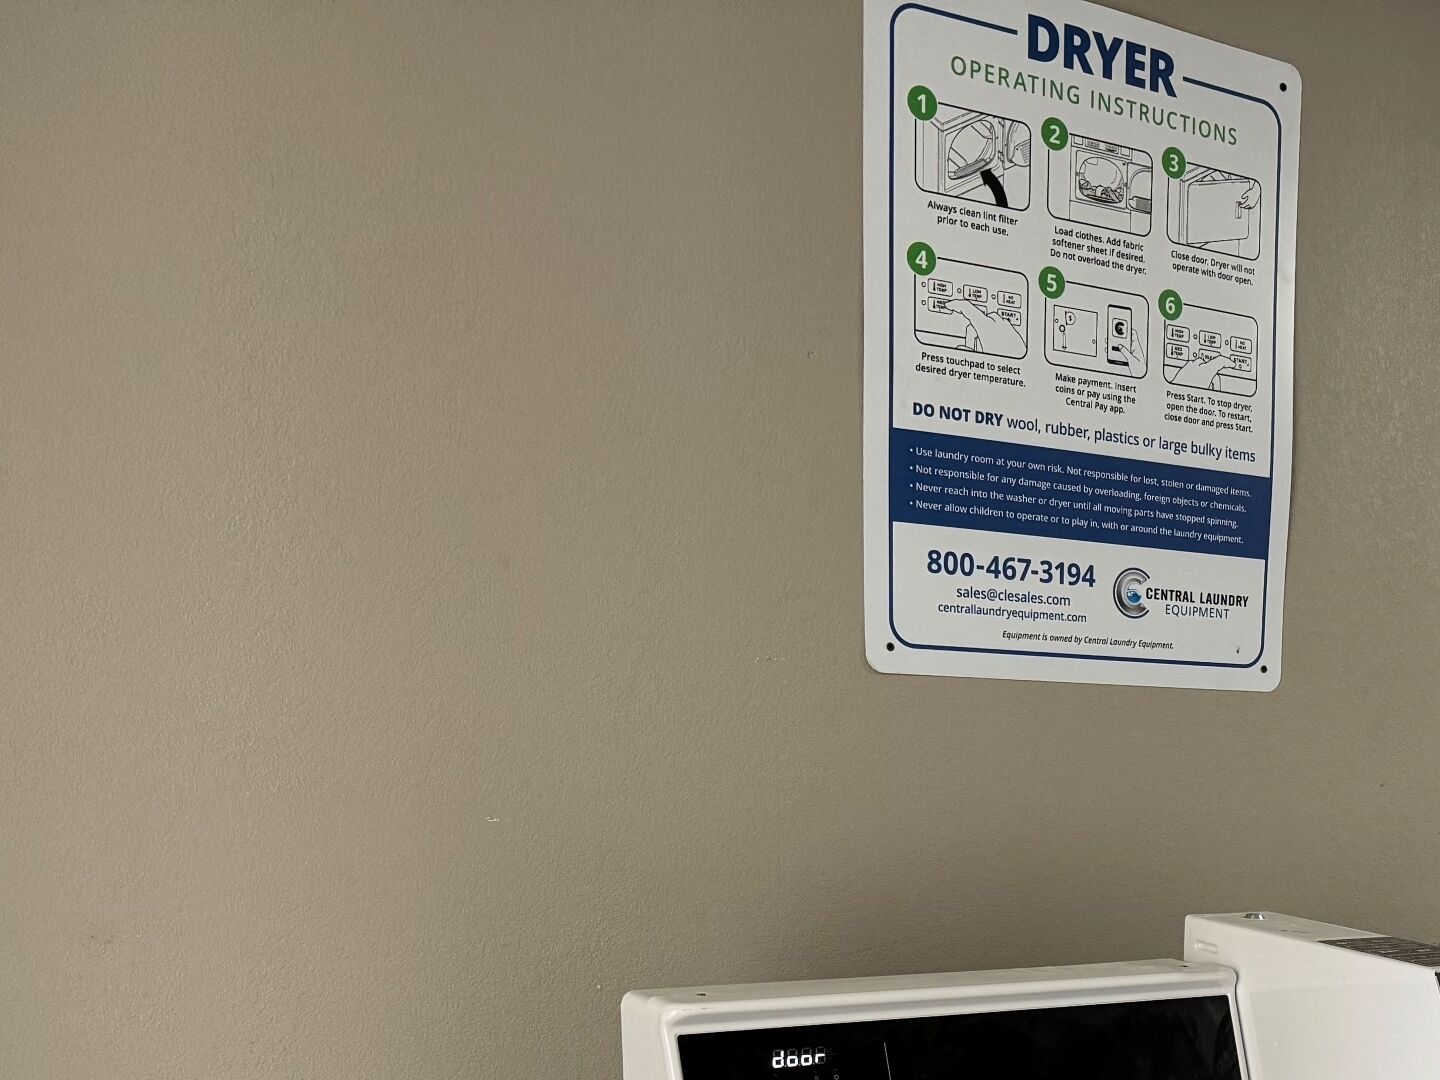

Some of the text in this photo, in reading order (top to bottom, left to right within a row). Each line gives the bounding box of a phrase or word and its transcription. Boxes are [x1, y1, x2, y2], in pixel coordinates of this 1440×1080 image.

[1028, 14, 1178, 97] DRYER
[918, 94, 928, 113] 1
[951, 56, 1237, 146] OPERATING INSTRUCTIONS
[1049, 125, 1060, 145] 2
[1169, 154, 1180, 173] 3
[927, 200, 1018, 225] Always clean lint filter
[937, 215, 1009, 236] prior to each use.
[1054, 226, 1144, 252] Load clothes. Add fabric
[915, 250, 928, 269] 4
[1052, 238, 1145, 263] softener sheet if desired.
[1050, 248, 1147, 275] Do not overload the dryer.
[1171, 250, 1255, 275] Close door. Dryer will not
[1046, 273, 1057, 292] 5
[1172, 263, 1253, 286] operate with door open.
[1165, 297, 1175, 315] 6
[922, 352, 1021, 375] Press touchpad to select
[915, 363, 1026, 387] desired dryer temperature.
[1055, 373, 1136, 393] Make payment. Insert
[1055, 385, 1075, 395] coins
[1087, 390, 1100, 401] pay
[1102, 393, 1122, 404] using
[1123, 395, 1136, 404] the
[1166, 390, 1253, 412] Press Start. To stop dryer,
[1065, 397, 1125, 415] Central Pay app.
[1166, 403, 1252, 423] open the door. To restart,
[913, 402, 1255, 462] DO NOT DRY wool, rubber, plastics or large bulky items
[1164, 413, 1253, 433] close door and press Start.
[916, 447, 933, 457] Use
[935, 448, 969, 464] laundry
[971, 455, 994, 465] room
[996, 458, 1005, 466] at
[1006, 460, 1026, 469] your
[1027, 462, 1046, 471] own
[1047, 464, 1065, 474] risk.
[1066, 466, 1082, 476] Not
[1083, 470, 1128, 482] responsible
[1130, 474, 1141, 483] for
[1143, 475, 1159, 487] lost,
[1161, 479, 1184, 488] stolen
[1195, 483, 1229, 496] damaged
[1230, 487, 1252, 498] items.
[927, 549, 1096, 587] 800-467-3194
[956, 586, 1071, 606] sales@clesales.com
[1146, 587, 1249, 607] CENTRAL LAUNDRY
[938, 604, 1087, 623] centrallaundryequipment.com
[1165, 604, 1230, 619] EQUIPMENT
[1002, 630, 1174, 649] Equipment is owned by Central Laundry Equipment.
[772, 1051, 826, 1068] door
